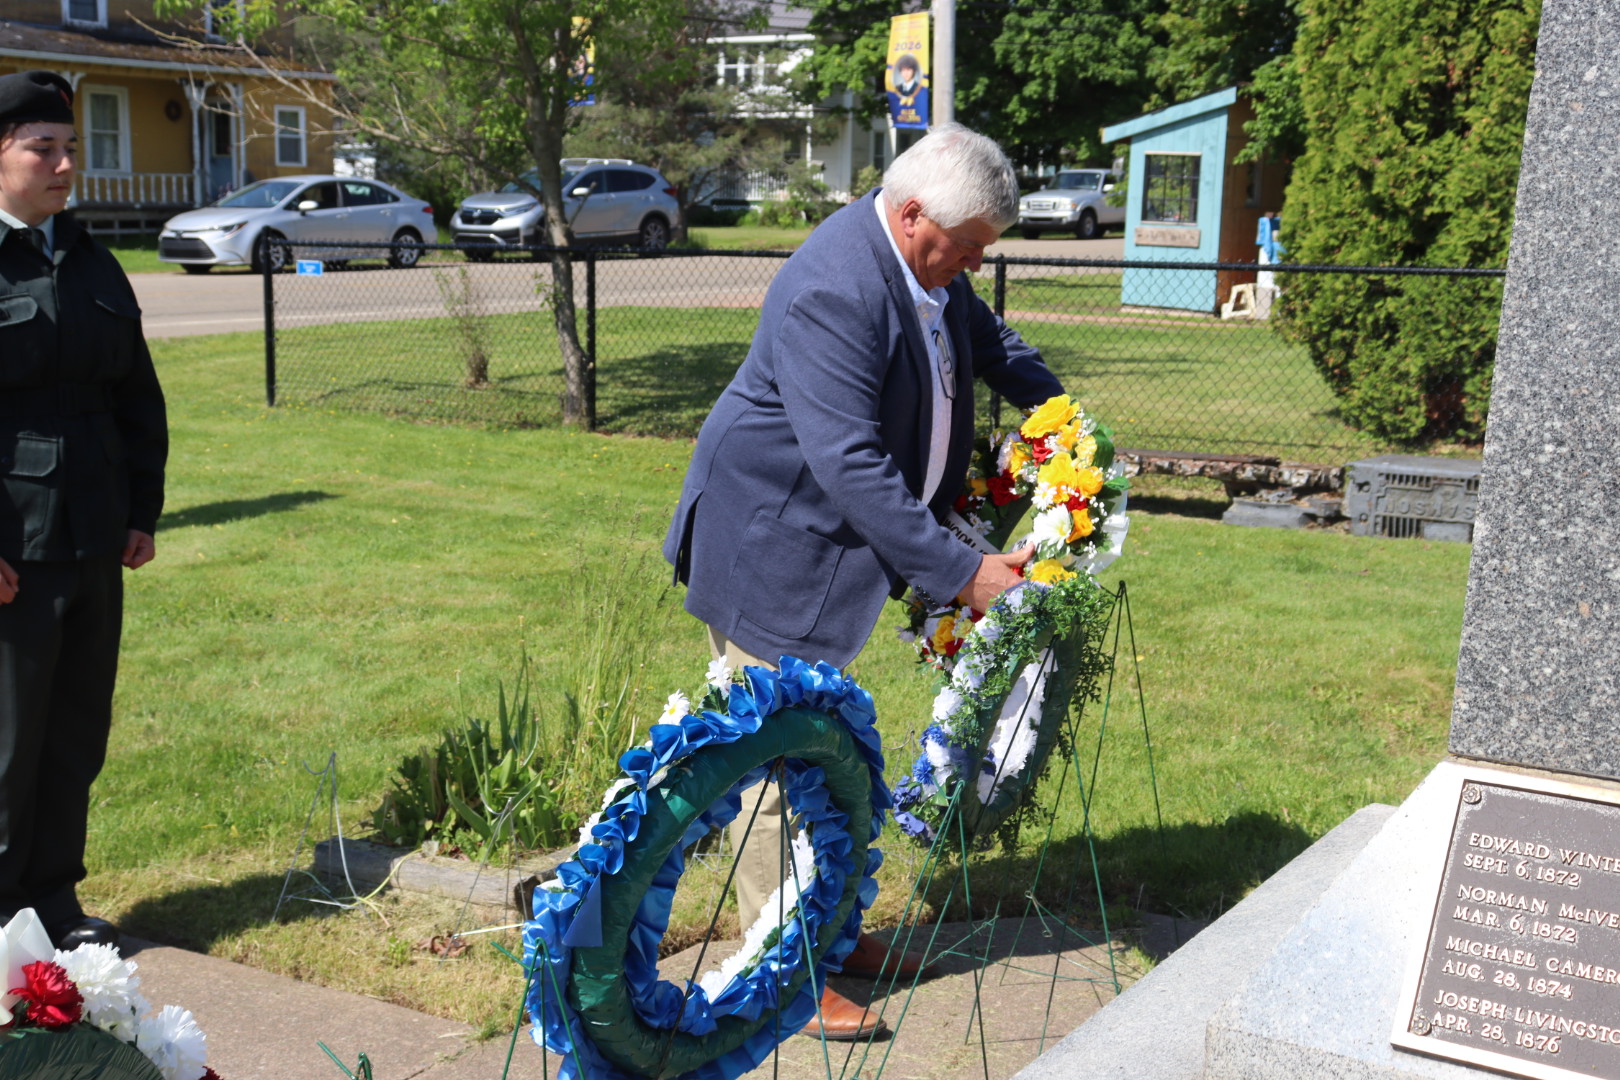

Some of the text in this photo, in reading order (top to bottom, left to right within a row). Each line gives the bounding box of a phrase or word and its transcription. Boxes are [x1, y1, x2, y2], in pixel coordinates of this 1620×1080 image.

[894, 41, 922, 52] 2026
[1468, 832, 1550, 859] EDWARD
[1463, 853, 1581, 888] SEPT. 6, 1872
[1452, 905, 1577, 943] MAR. 6, 1872
[1457, 884, 1620, 929] NORMAN McIVE
[1445, 935, 1537, 968] MICHAEL
[1441, 959, 1572, 999] AUG. 28, 1874
[1433, 989, 1507, 1019] JOSEPH
[1431, 1011, 1561, 1053] APR. 28, 1876
